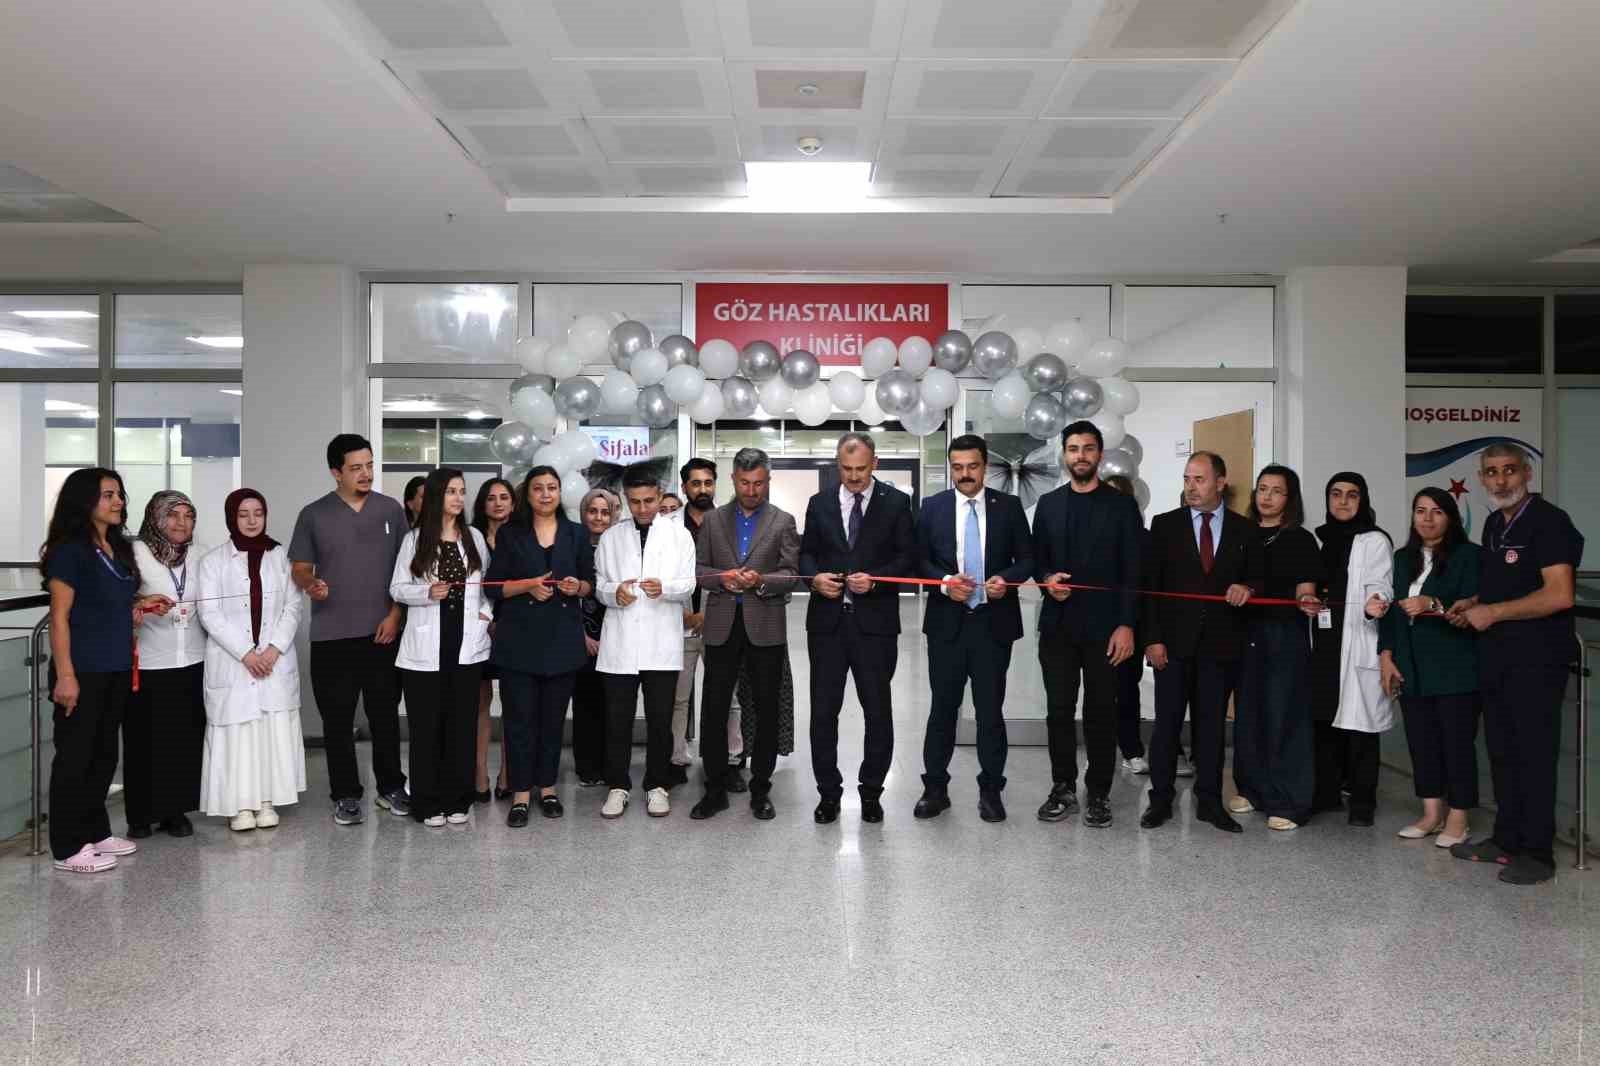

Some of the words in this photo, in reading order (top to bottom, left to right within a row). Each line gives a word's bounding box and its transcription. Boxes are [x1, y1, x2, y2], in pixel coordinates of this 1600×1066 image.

[714, 299, 763, 322] GÖZ
[769, 302, 931, 323] HASTALIKLARI
[1405, 405, 1521, 424] OŞGELDİNİZ
